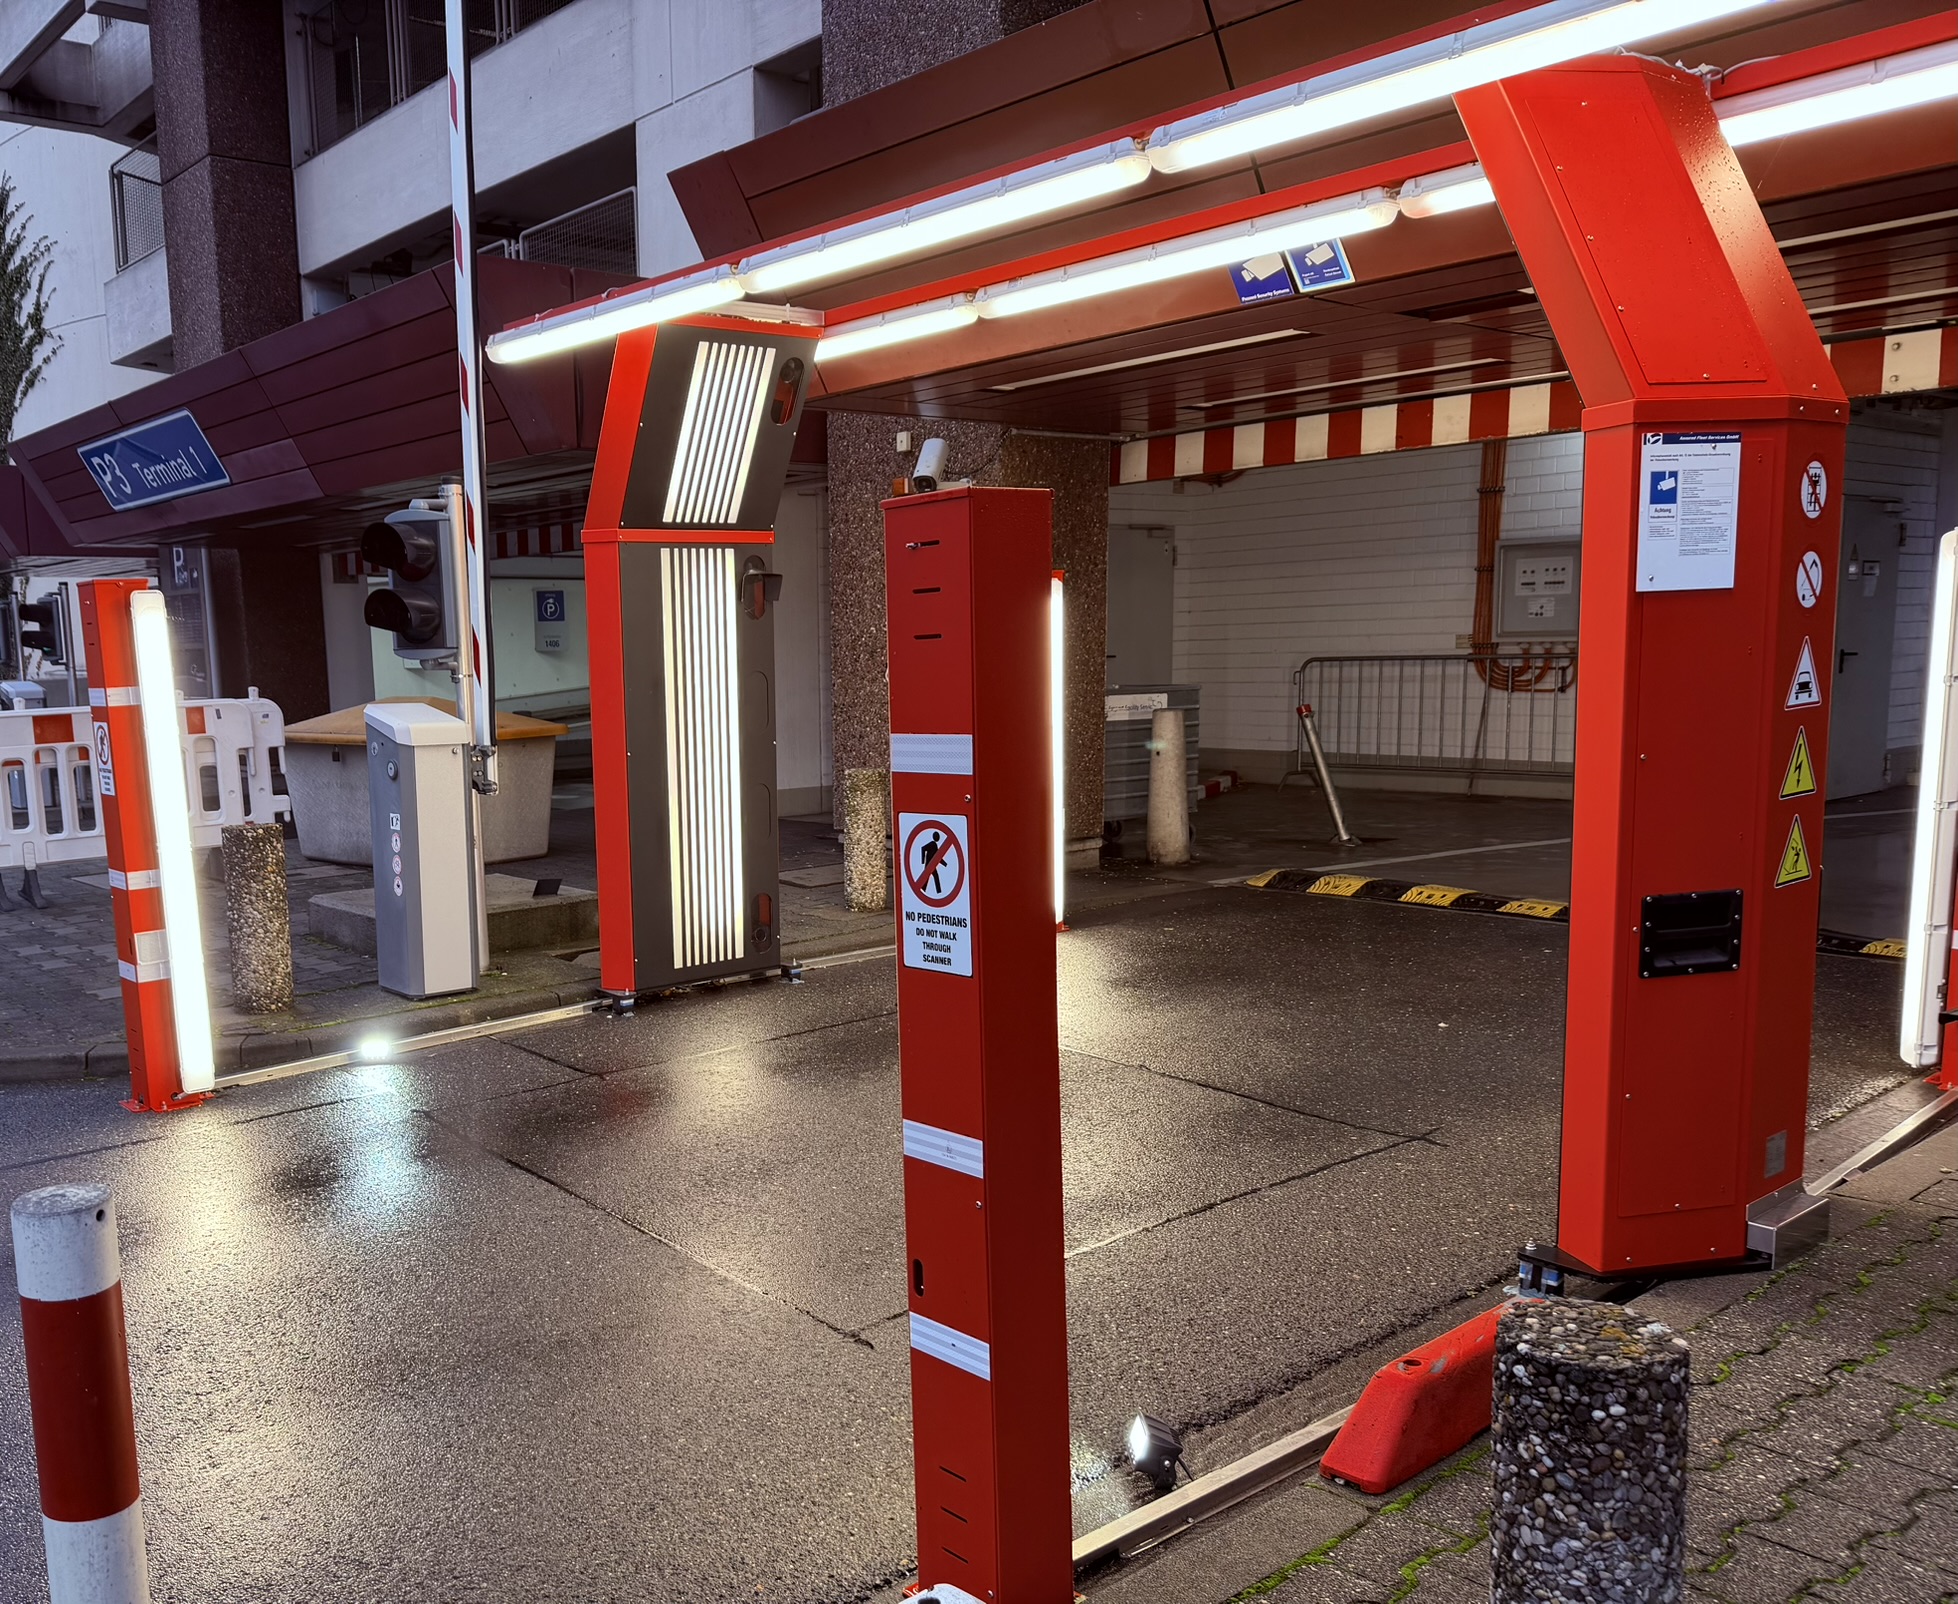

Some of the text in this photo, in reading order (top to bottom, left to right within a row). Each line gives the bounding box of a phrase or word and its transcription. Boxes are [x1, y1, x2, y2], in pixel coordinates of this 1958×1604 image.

[91, 446, 207, 497] P3 Terminal 1
[545, 640, 560, 648] 1406
[905, 911, 968, 928] NO PEDESTRIANS
[916, 927, 957, 941] DO NOT WALK
[922, 941, 951, 953] THROUGH
[922, 954, 952, 966] SCANNER
